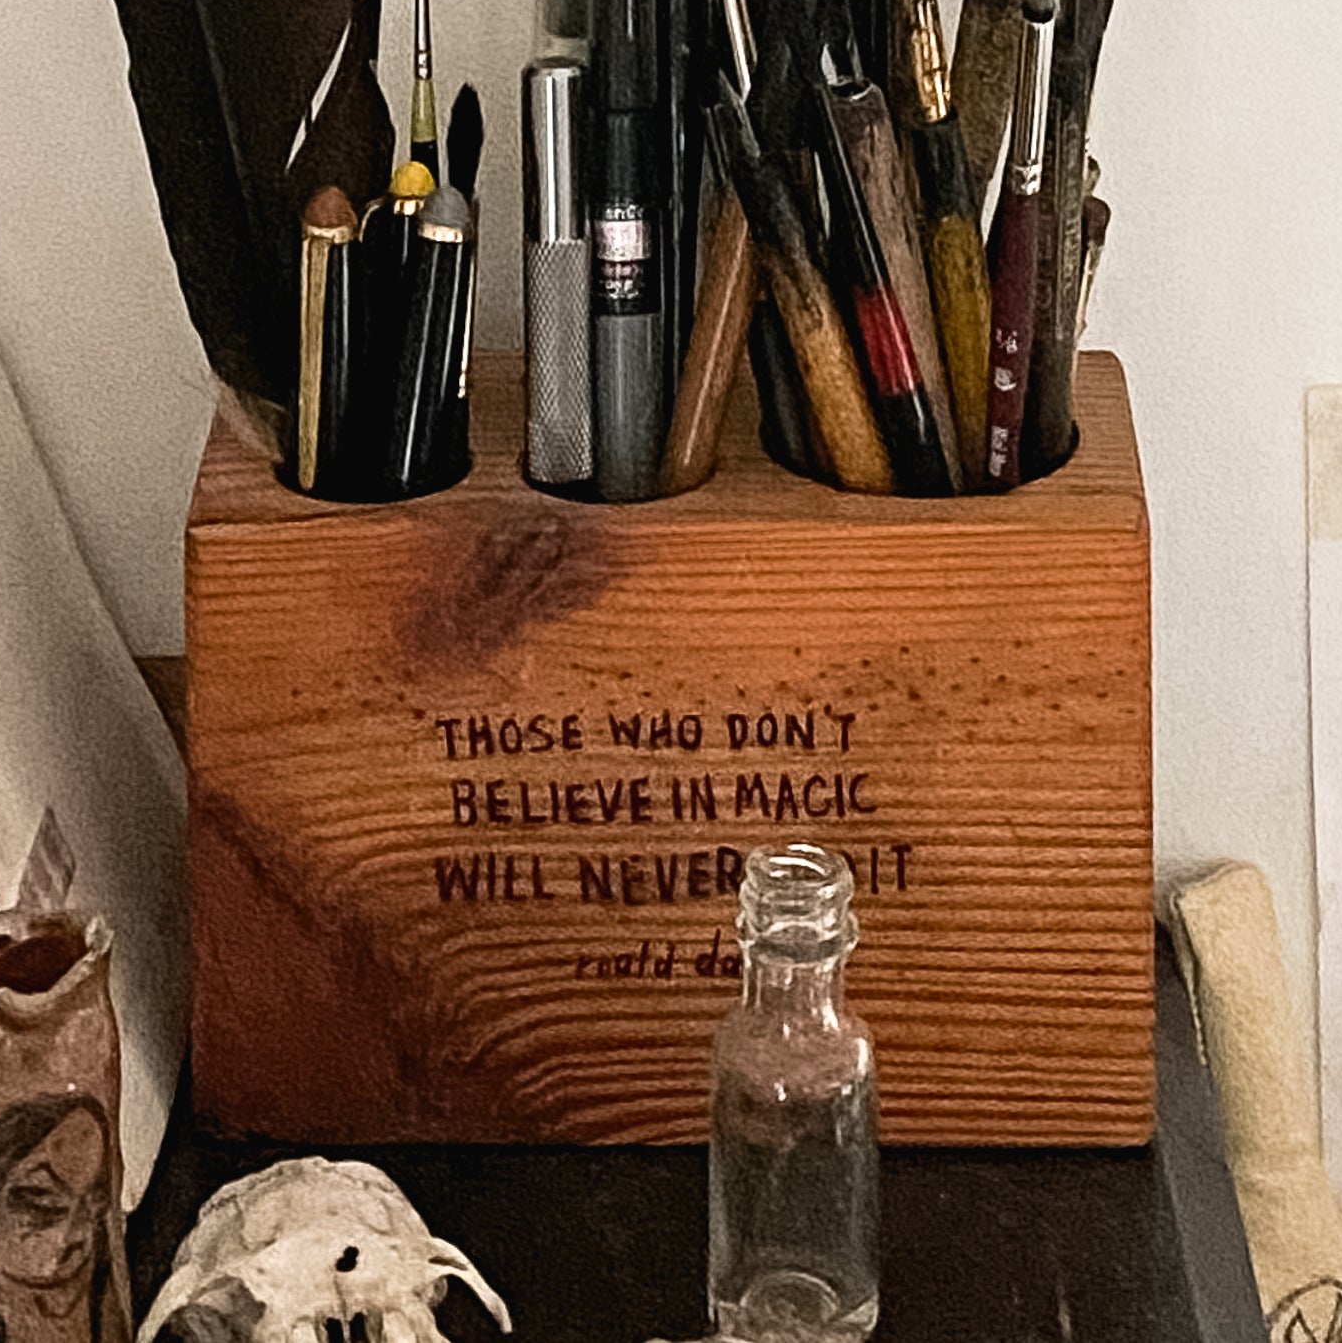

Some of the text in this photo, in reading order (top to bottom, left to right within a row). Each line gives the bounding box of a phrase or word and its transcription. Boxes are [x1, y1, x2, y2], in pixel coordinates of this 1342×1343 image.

[434, 704, 857, 760] THOSE WHO DON'T
[451, 772, 879, 827] BELIEVE IN MAGIC
[435, 851, 557, 903] WILL
[578, 846, 742, 905] NEVER
[870, 843, 913, 895] IT
[694, 928, 742, 978] da
